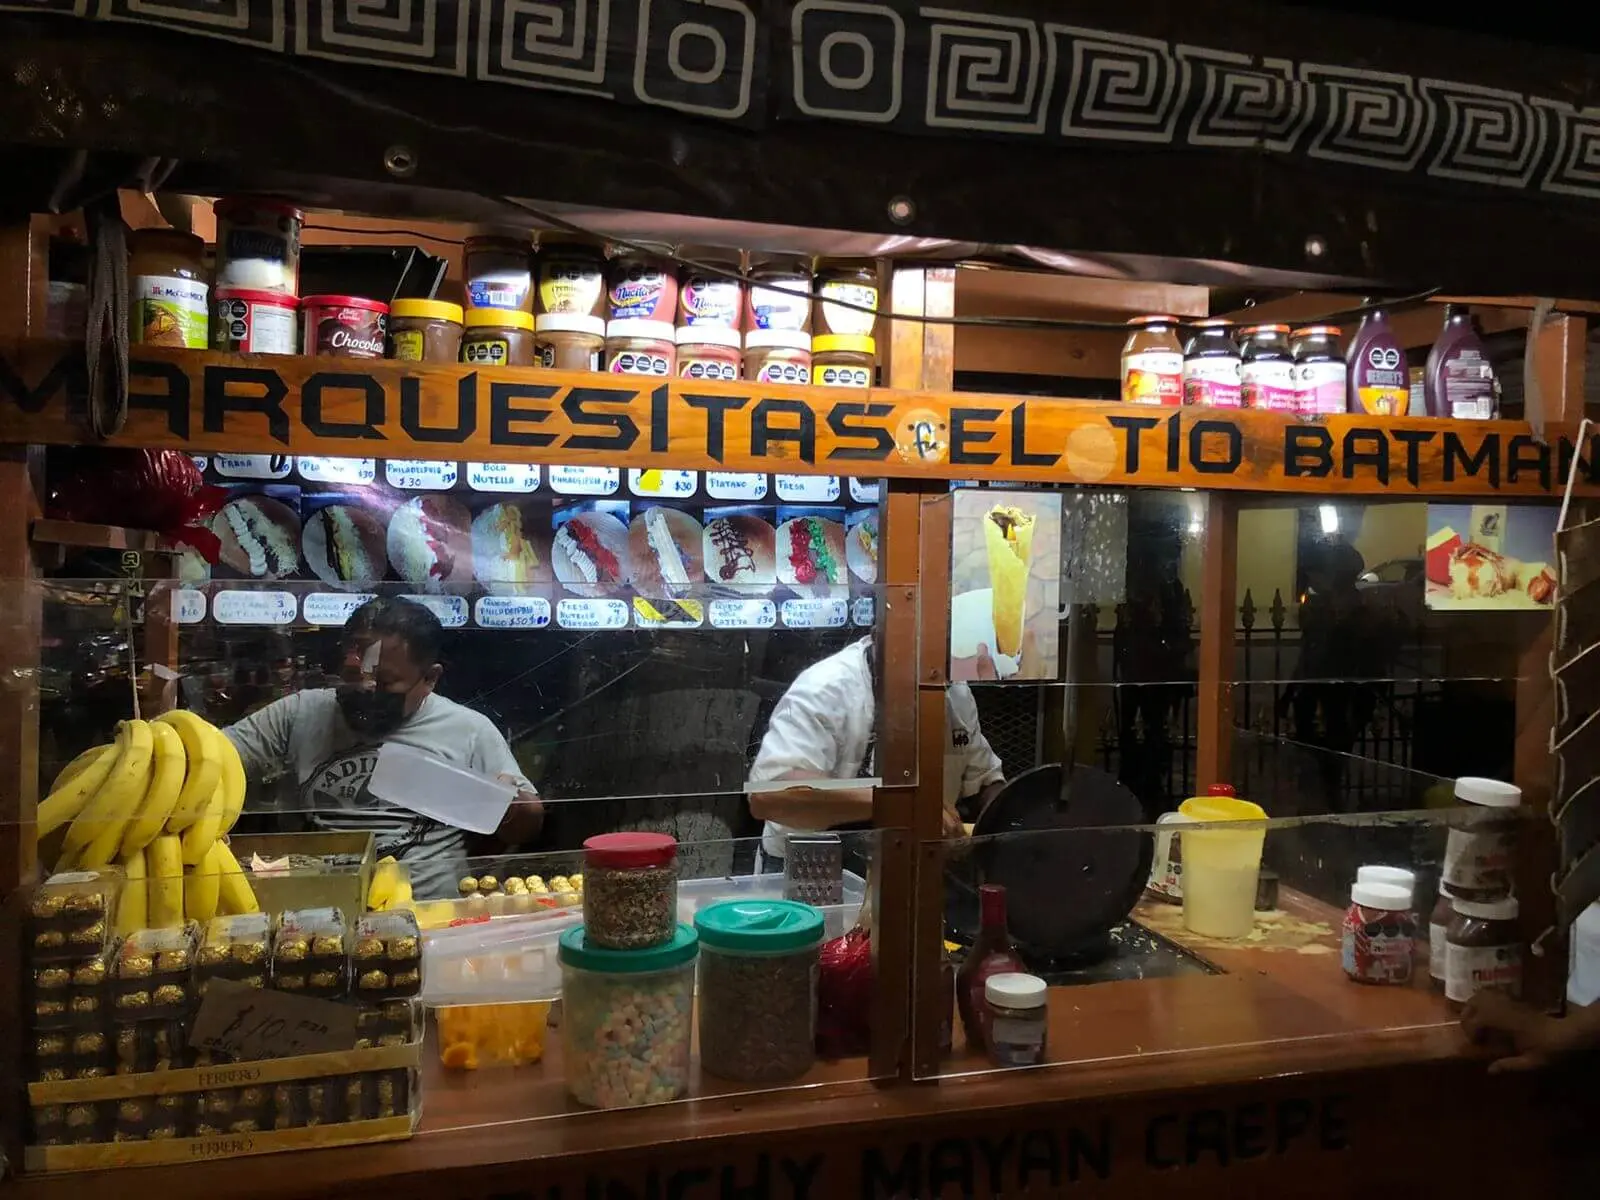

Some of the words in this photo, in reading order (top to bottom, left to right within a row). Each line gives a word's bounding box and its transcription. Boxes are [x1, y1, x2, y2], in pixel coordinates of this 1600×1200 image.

[949, 402, 1062, 467] EL
[1284, 424, 1600, 491] BATMAN
[473, 474, 516, 485] NUTELLA
